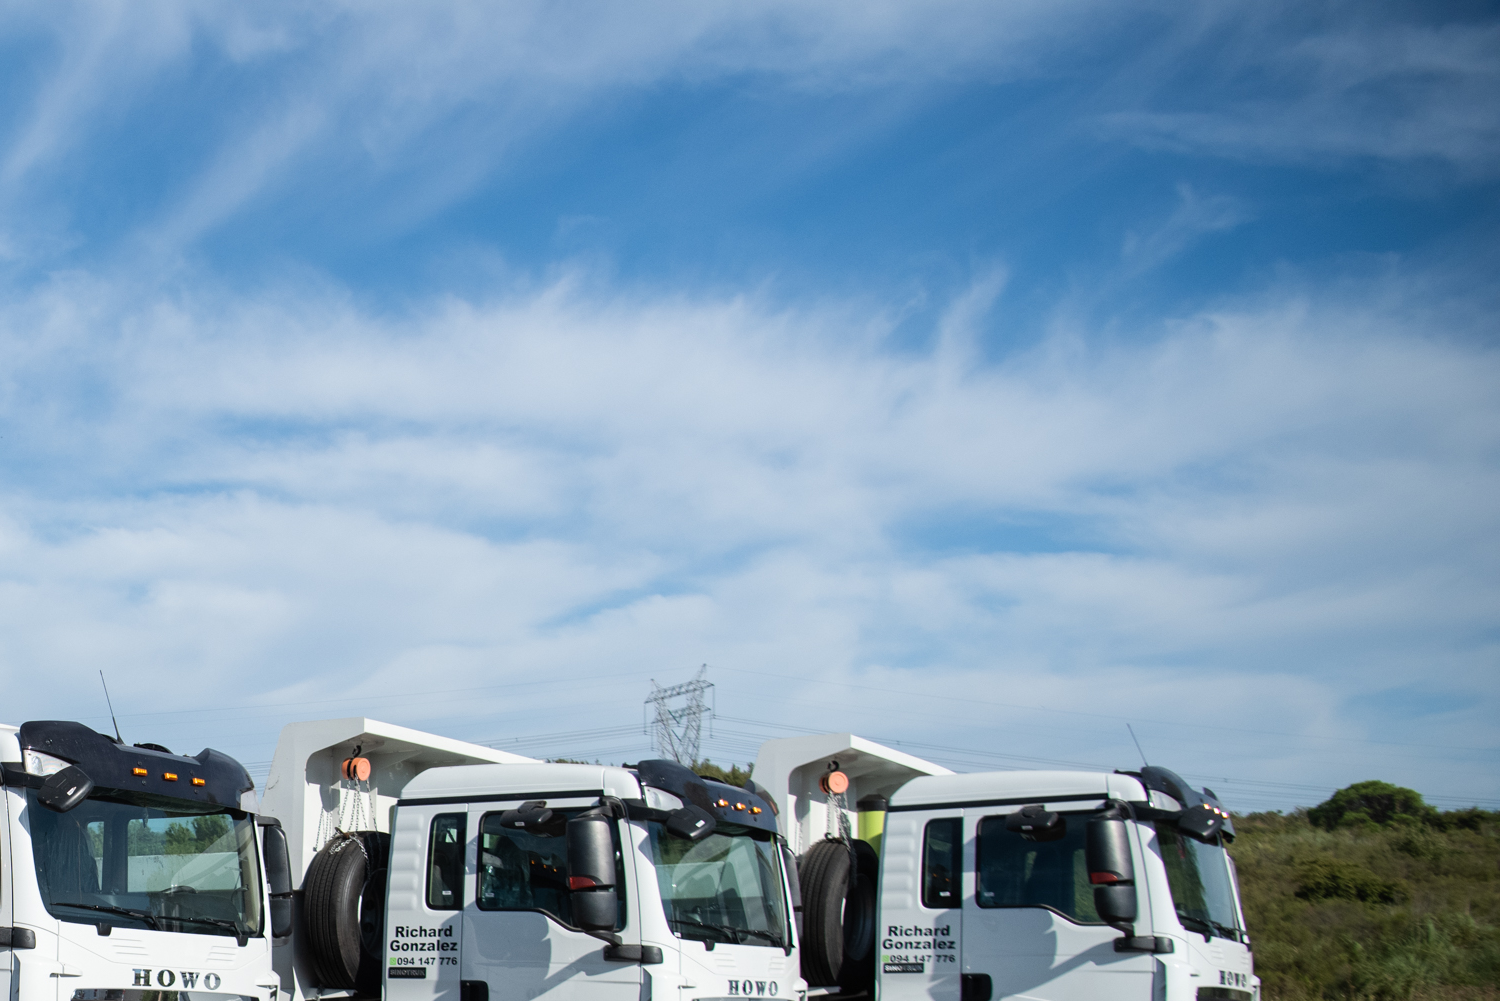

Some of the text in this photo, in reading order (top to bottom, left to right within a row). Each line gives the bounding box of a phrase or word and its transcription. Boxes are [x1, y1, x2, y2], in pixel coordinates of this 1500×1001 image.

[395, 925, 453, 938] Richard
[888, 925, 951, 937] Richard
[390, 939, 458, 952] Gonzalez
[882, 938, 956, 950] Gonzalez
[397, 957, 458, 966] 094 147 776
[890, 954, 956, 963] 094 147 776
[132, 968, 221, 990] HOWO
[727, 979, 778, 996] HOWO
